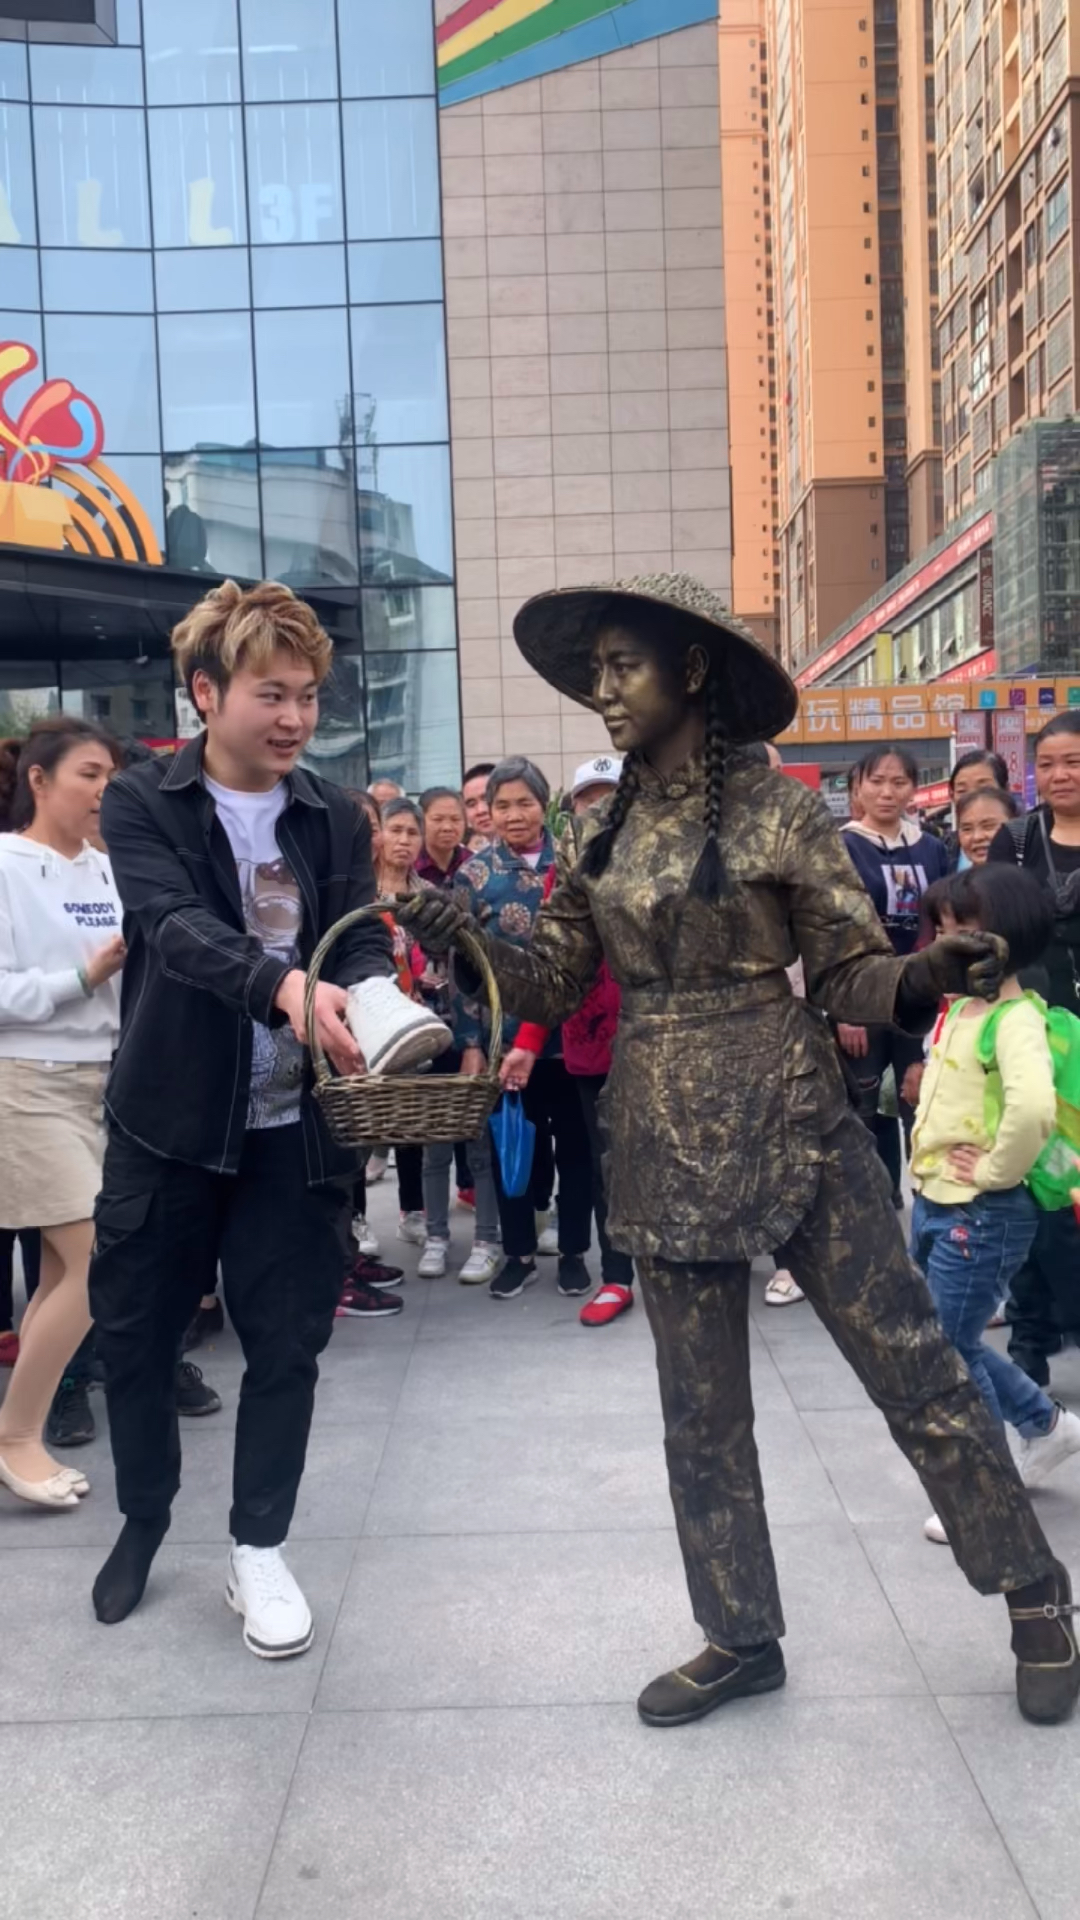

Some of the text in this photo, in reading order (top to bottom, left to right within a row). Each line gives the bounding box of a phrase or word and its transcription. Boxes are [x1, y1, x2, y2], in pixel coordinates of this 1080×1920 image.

[258, 183, 333, 243] 3F
[784, 693, 966, 735] 玩精品馆
